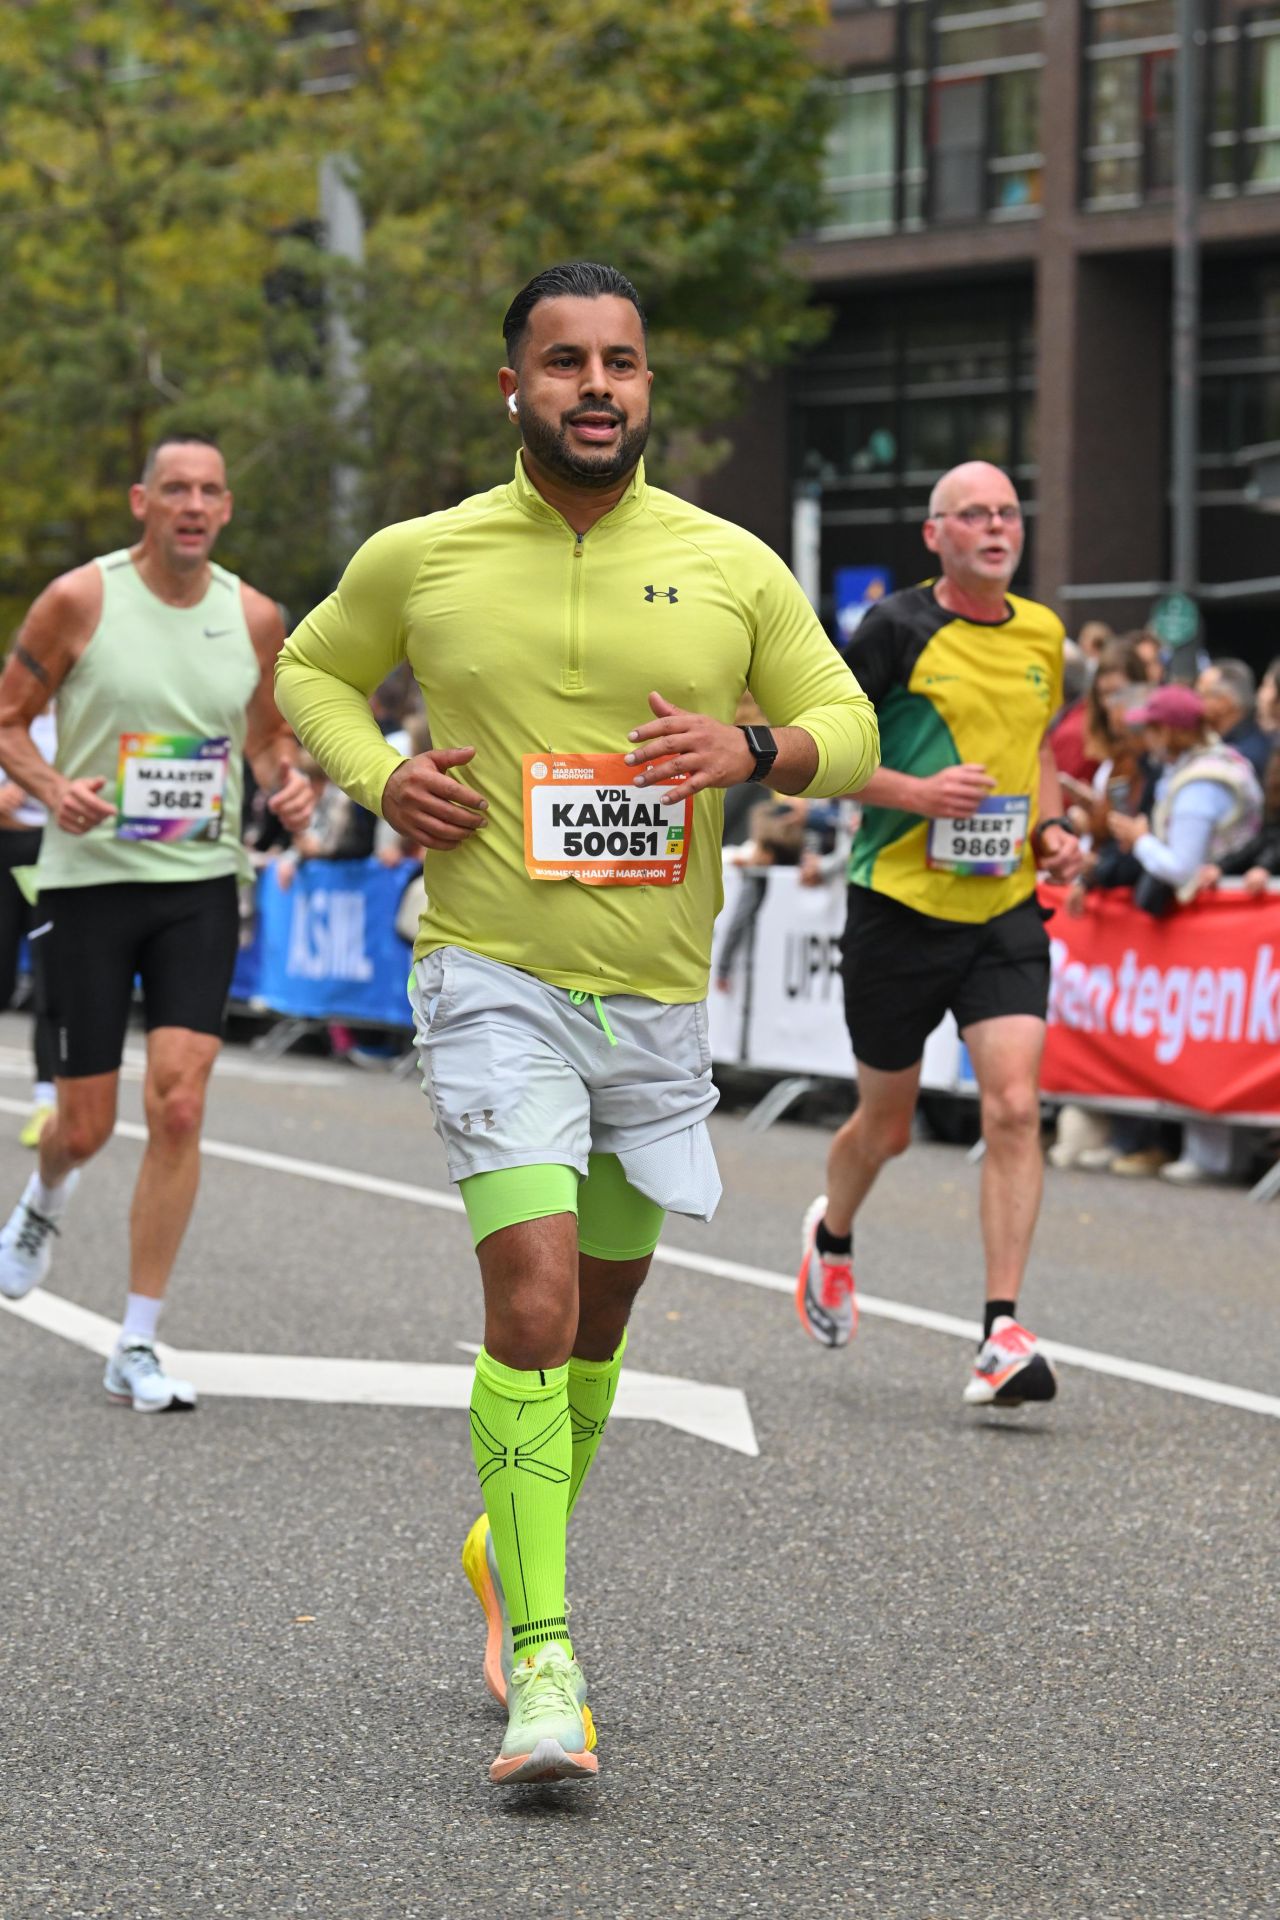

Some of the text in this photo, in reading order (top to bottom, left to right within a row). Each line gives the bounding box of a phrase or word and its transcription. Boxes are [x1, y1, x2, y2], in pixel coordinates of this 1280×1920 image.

[138, 769, 214, 781] MAARTEN
[148, 790, 204, 809] 3682
[596, 789, 631, 802] VDL
[552, 804, 668, 827] KAMAL
[563, 831, 658, 857] 50051
[952, 837, 1011, 857] 9869
[582, 868, 615, 878] HALVE
[616, 868, 666, 878] MARATHON
[1112, 948, 1247, 1065] tegen
[1246, 943, 1280, 1044] k
